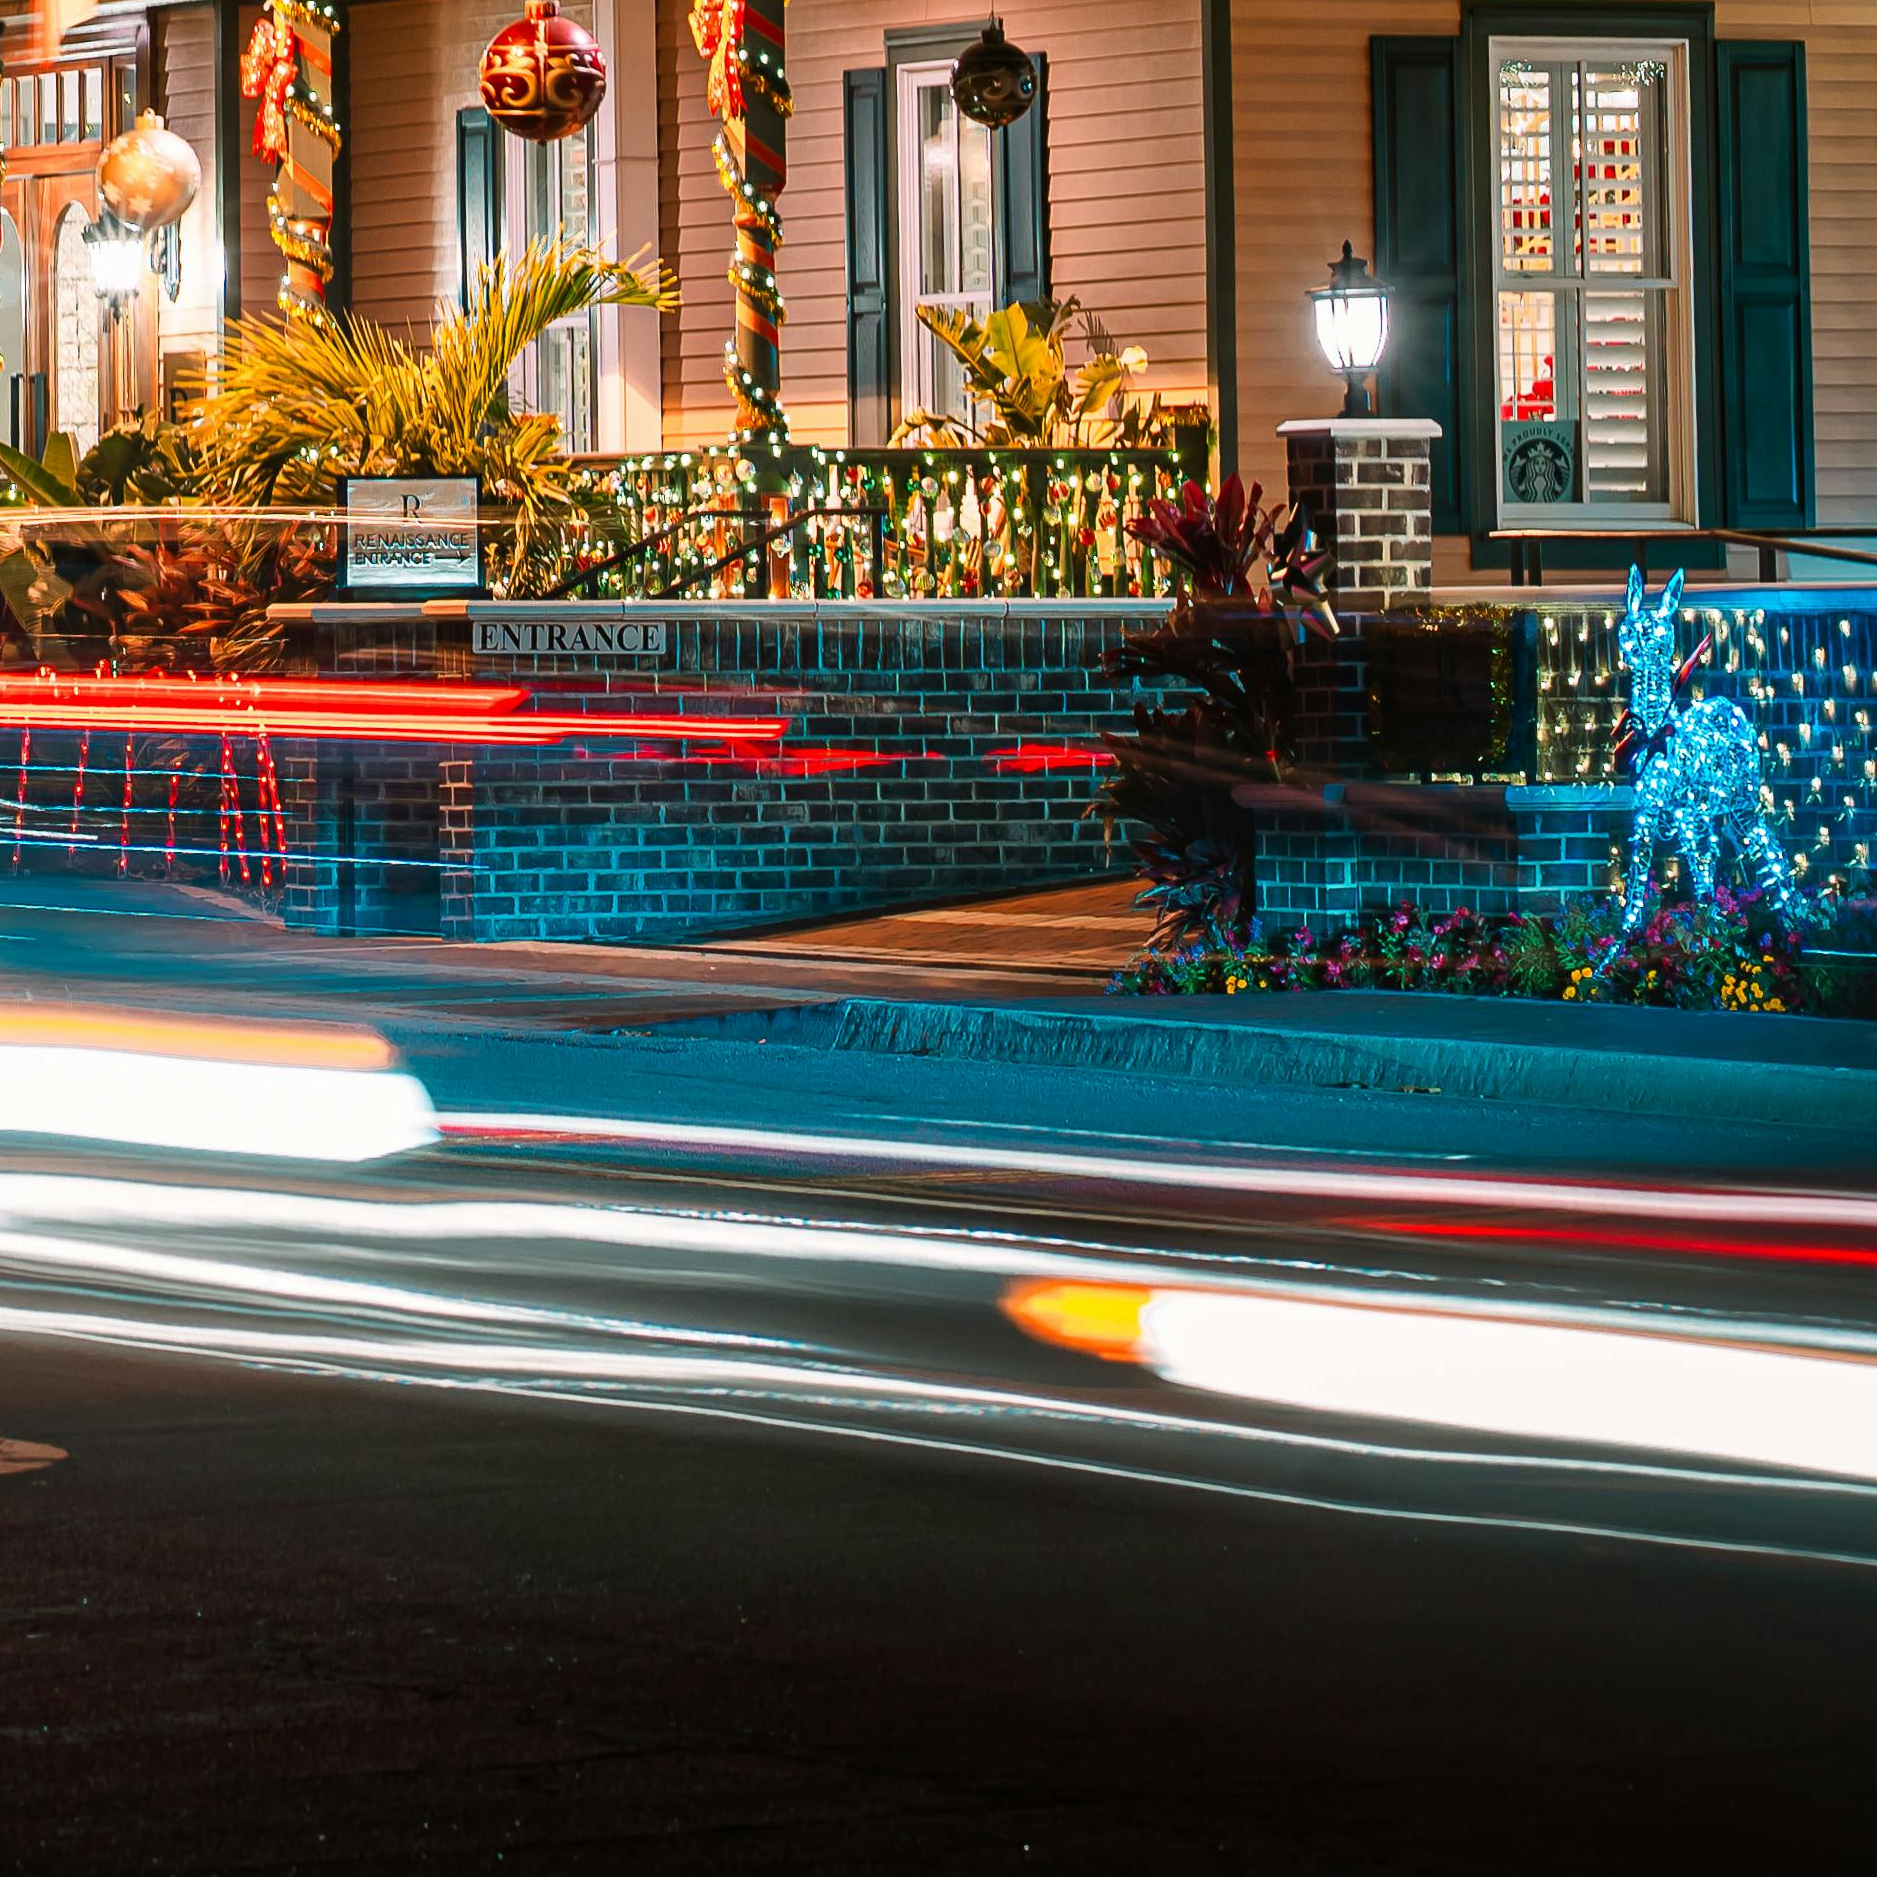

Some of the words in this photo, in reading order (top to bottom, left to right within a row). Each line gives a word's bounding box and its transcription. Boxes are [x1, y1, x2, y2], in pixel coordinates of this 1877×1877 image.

[401, 494, 421, 524] R
[354, 533, 469, 547] RENAISSANCE
[355, 552, 432, 565] ENTRANCE
[480, 623, 660, 652] ENTRANCE
